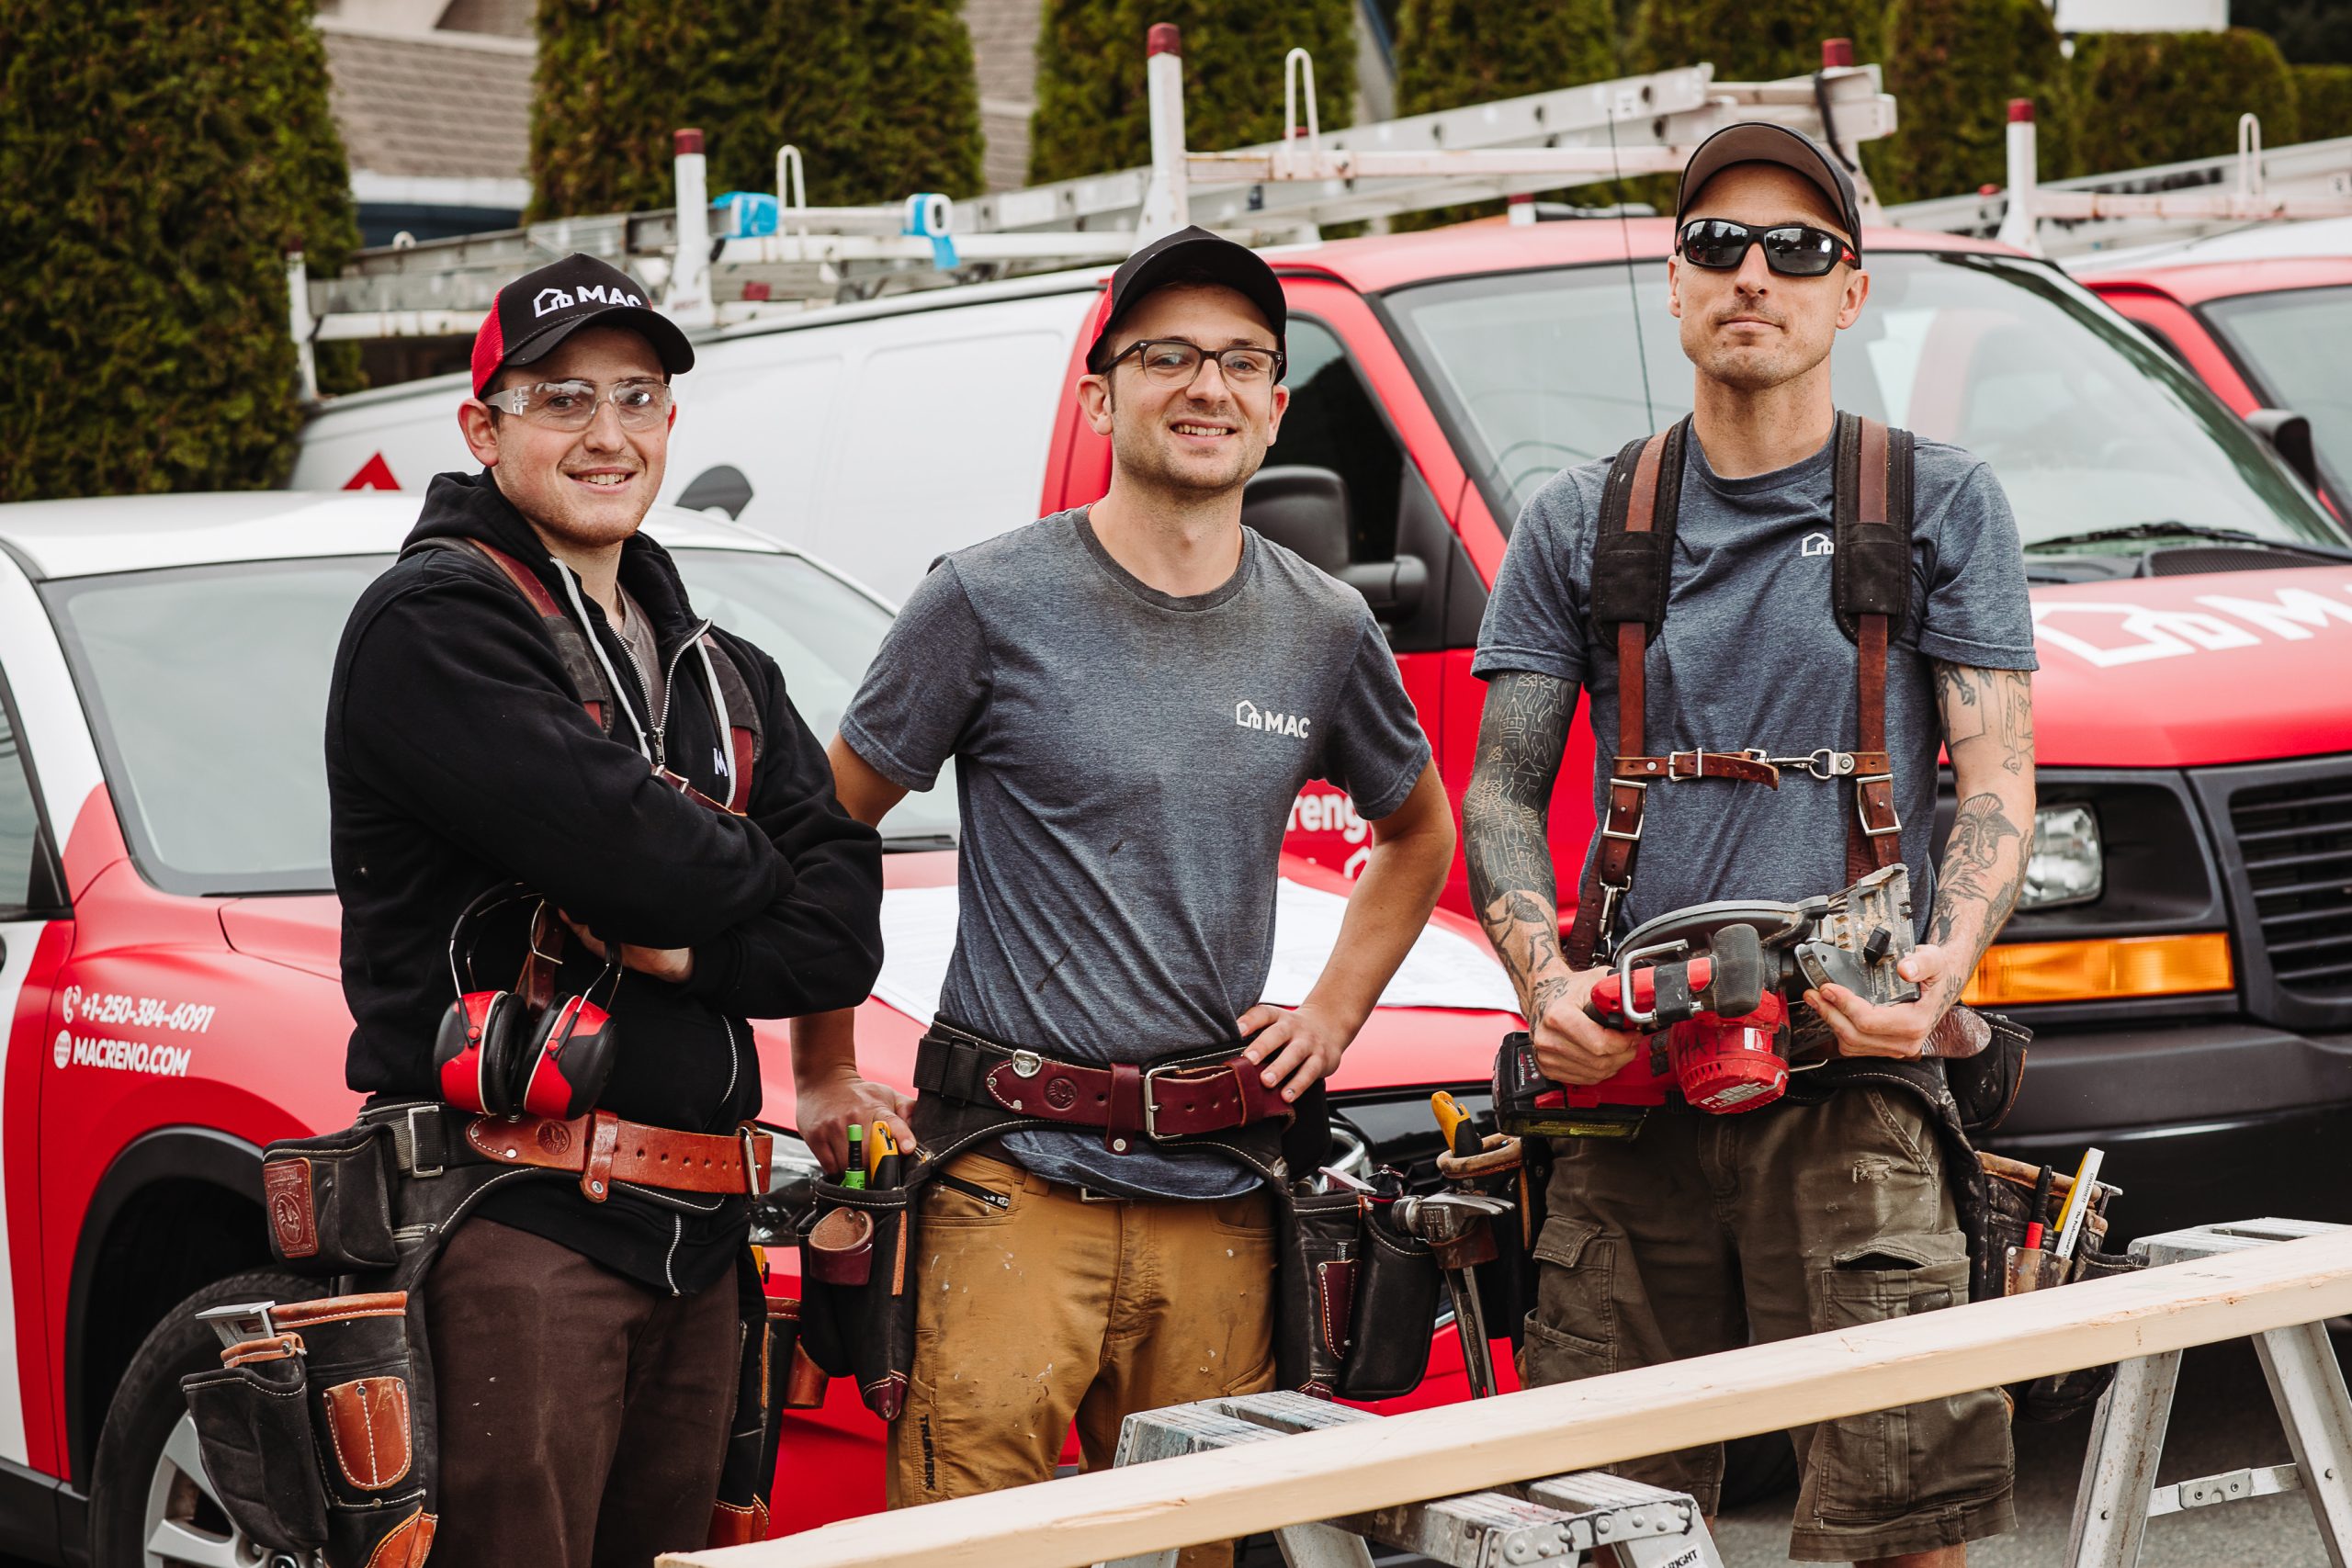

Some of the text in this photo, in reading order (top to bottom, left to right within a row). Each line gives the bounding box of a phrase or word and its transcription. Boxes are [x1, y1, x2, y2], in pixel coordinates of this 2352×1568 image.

[1265, 710, 1311, 739] MAC
[82, 992, 216, 1033] +1-250-384-6091
[73, 1035, 191, 1077] MACRENO.COM
[1664, 1549, 1698, 1568] RIGHT
